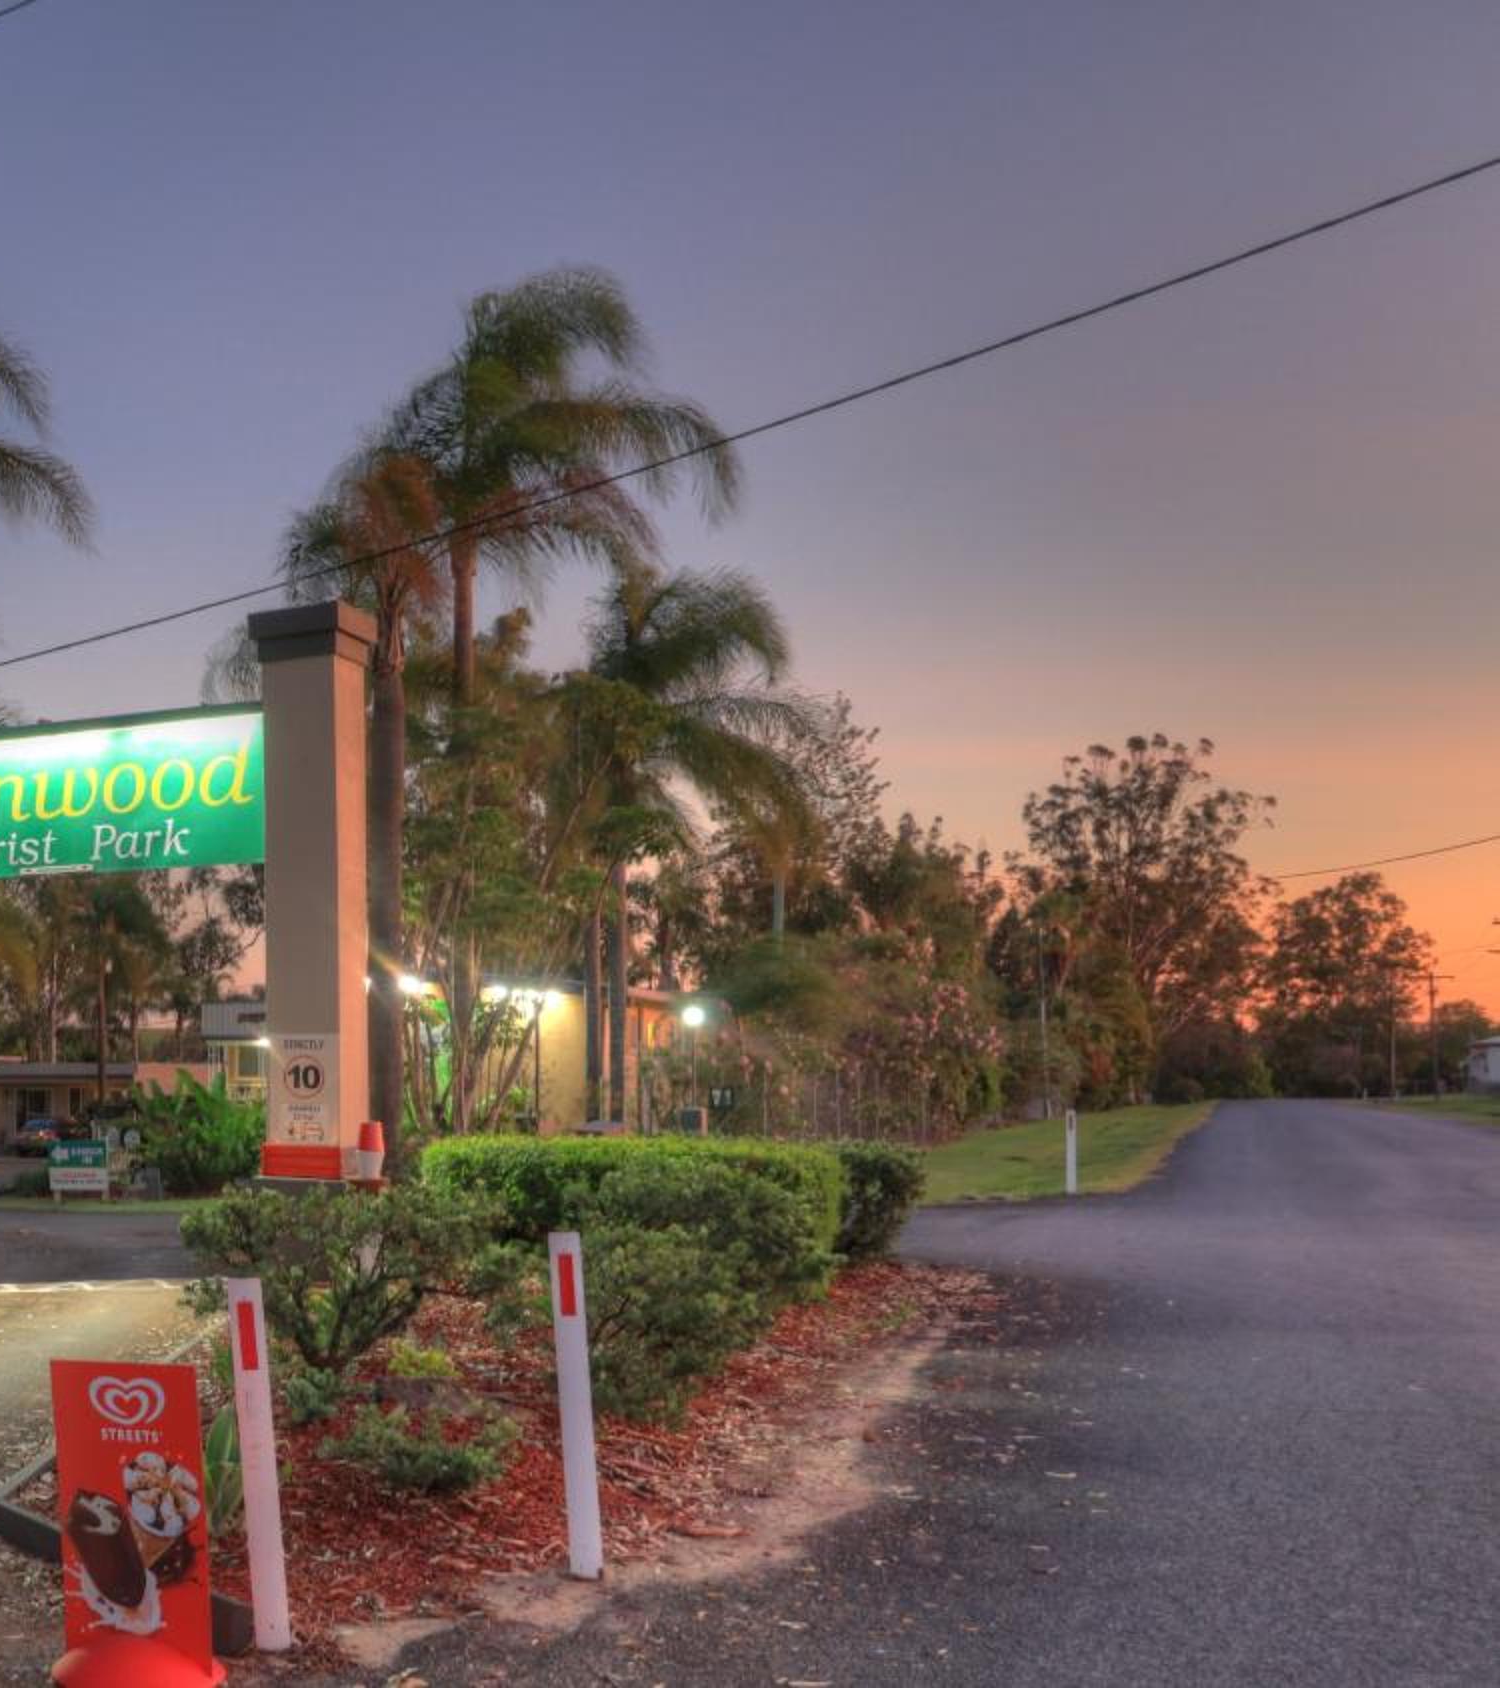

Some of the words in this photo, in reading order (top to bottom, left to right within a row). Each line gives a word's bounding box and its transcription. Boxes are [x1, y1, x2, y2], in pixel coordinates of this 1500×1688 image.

[91, 819, 190, 862] Park
[288, 1064, 320, 1089] 10
[100, 1428, 160, 1442] STREETS
